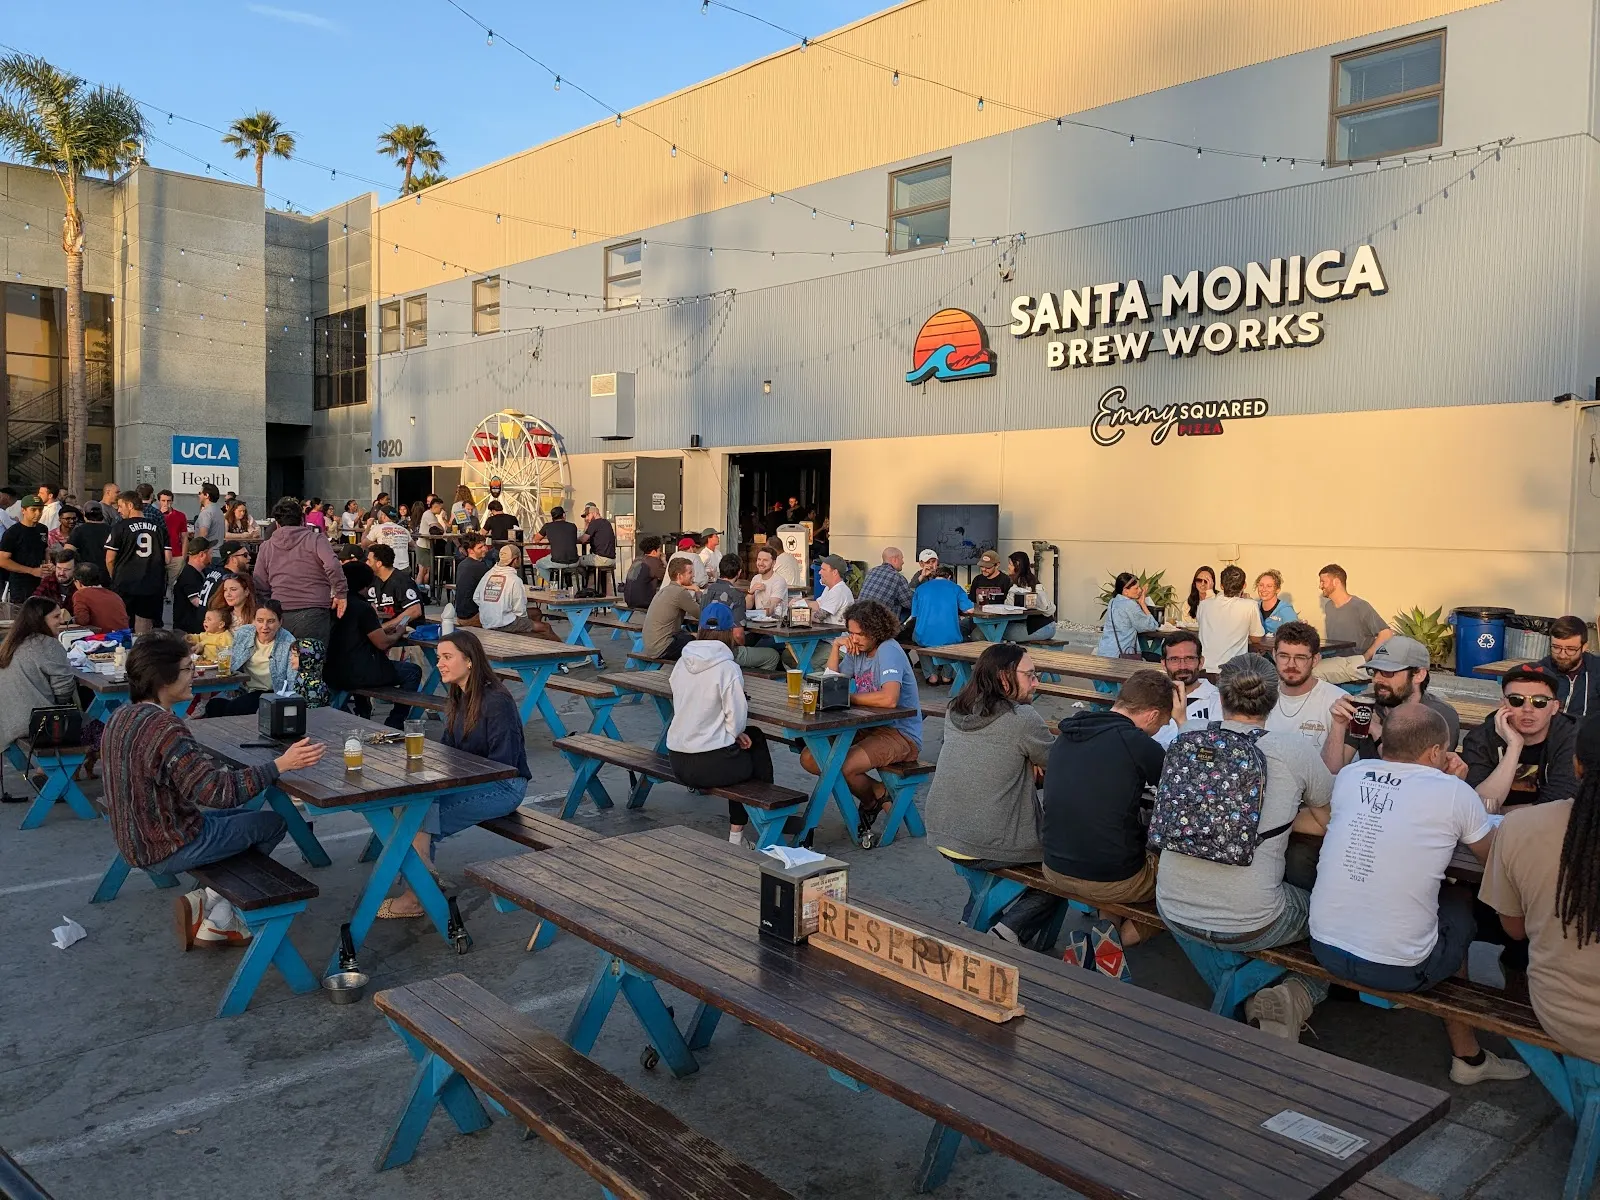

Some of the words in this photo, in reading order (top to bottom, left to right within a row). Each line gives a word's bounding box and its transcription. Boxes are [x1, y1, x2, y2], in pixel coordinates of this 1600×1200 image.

[1009, 279, 1148, 336] SANTA
[1161, 244, 1387, 318] MONICA
[1047, 330, 1150, 369] BREW
[1162, 311, 1323, 356] WORKS
[1092, 386, 1178, 445] Emmy
[1179, 400, 1266, 420] SQUARED
[1179, 423, 1223, 436] PIZZA
[180, 442, 231, 459] UCLA
[377, 439, 403, 458] 1920
[181, 471, 231, 486] Health
[136, 532, 153, 558] 9
[1362, 771, 1402, 787] Ado
[1360, 785, 1394, 814] Wish
[1349, 873, 1365, 883] 2024
[822, 900, 1010, 1004] RESERVED
